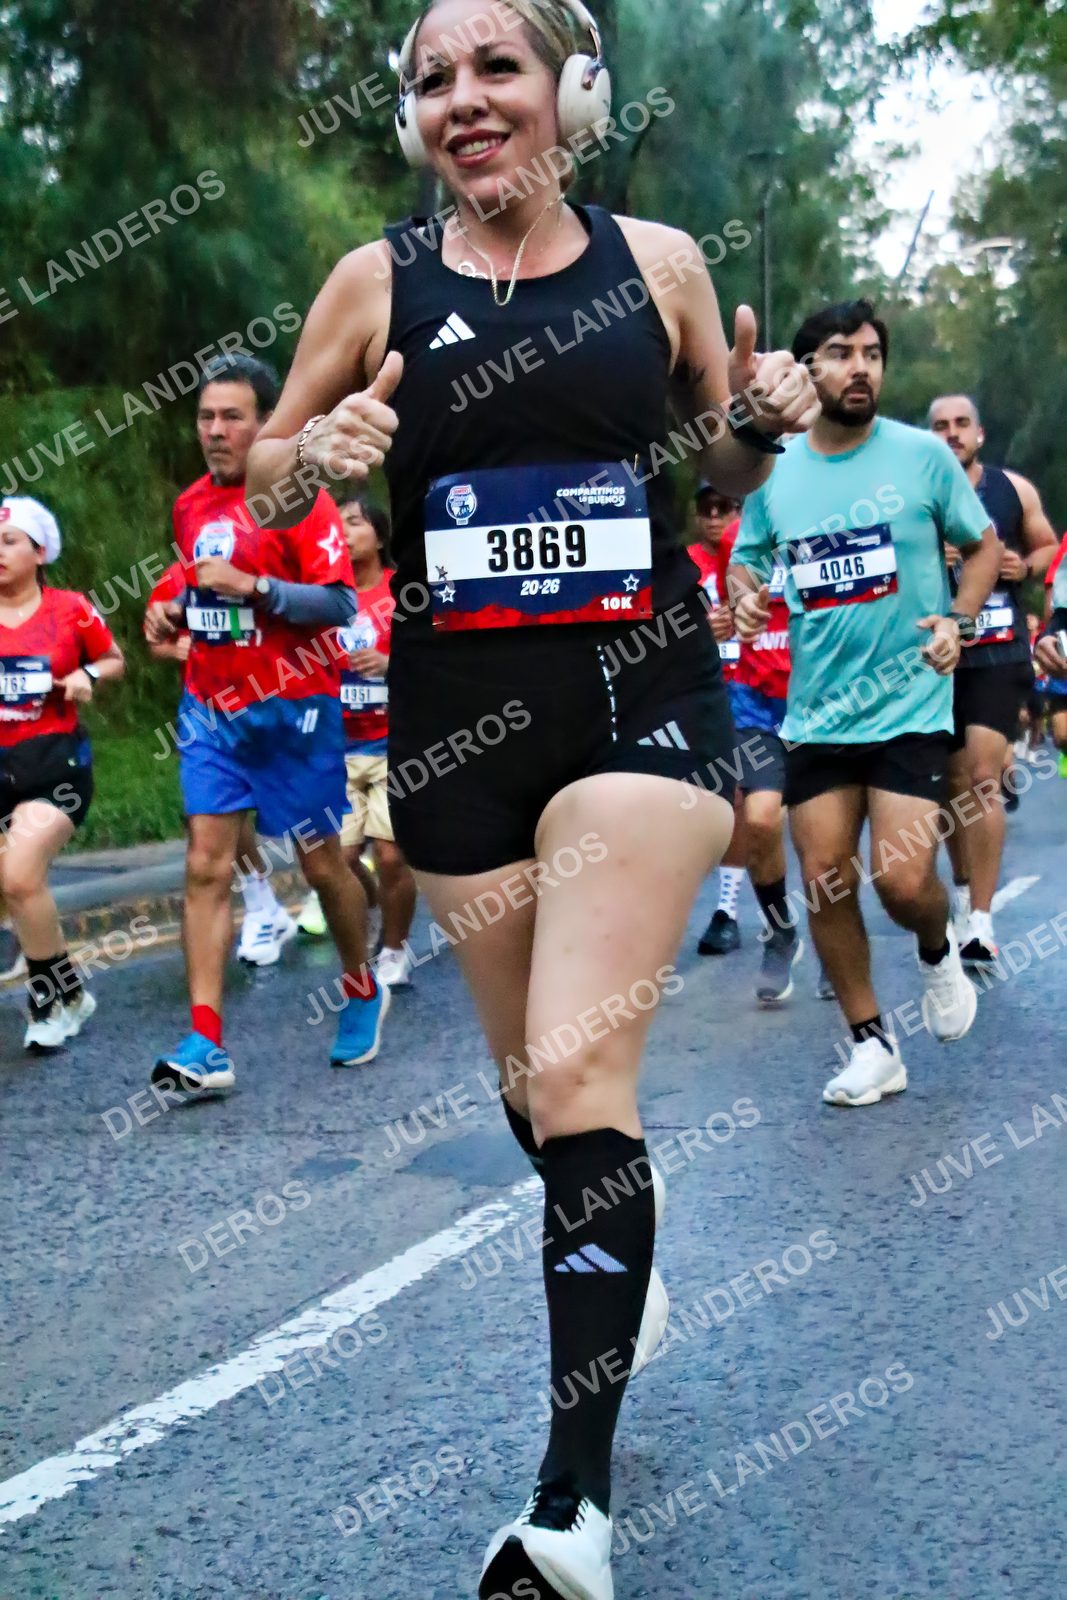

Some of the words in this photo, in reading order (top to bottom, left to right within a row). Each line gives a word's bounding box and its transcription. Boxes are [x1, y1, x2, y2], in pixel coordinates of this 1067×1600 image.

[556, 487, 625, 496] COMPARTIMOS
[487, 524, 586, 572] 3869
[820, 556, 864, 581] 4046
[601, 597, 632, 610] 10K
[202, 611, 226, 629] 4147
[0, 676, 26, 692] 762
